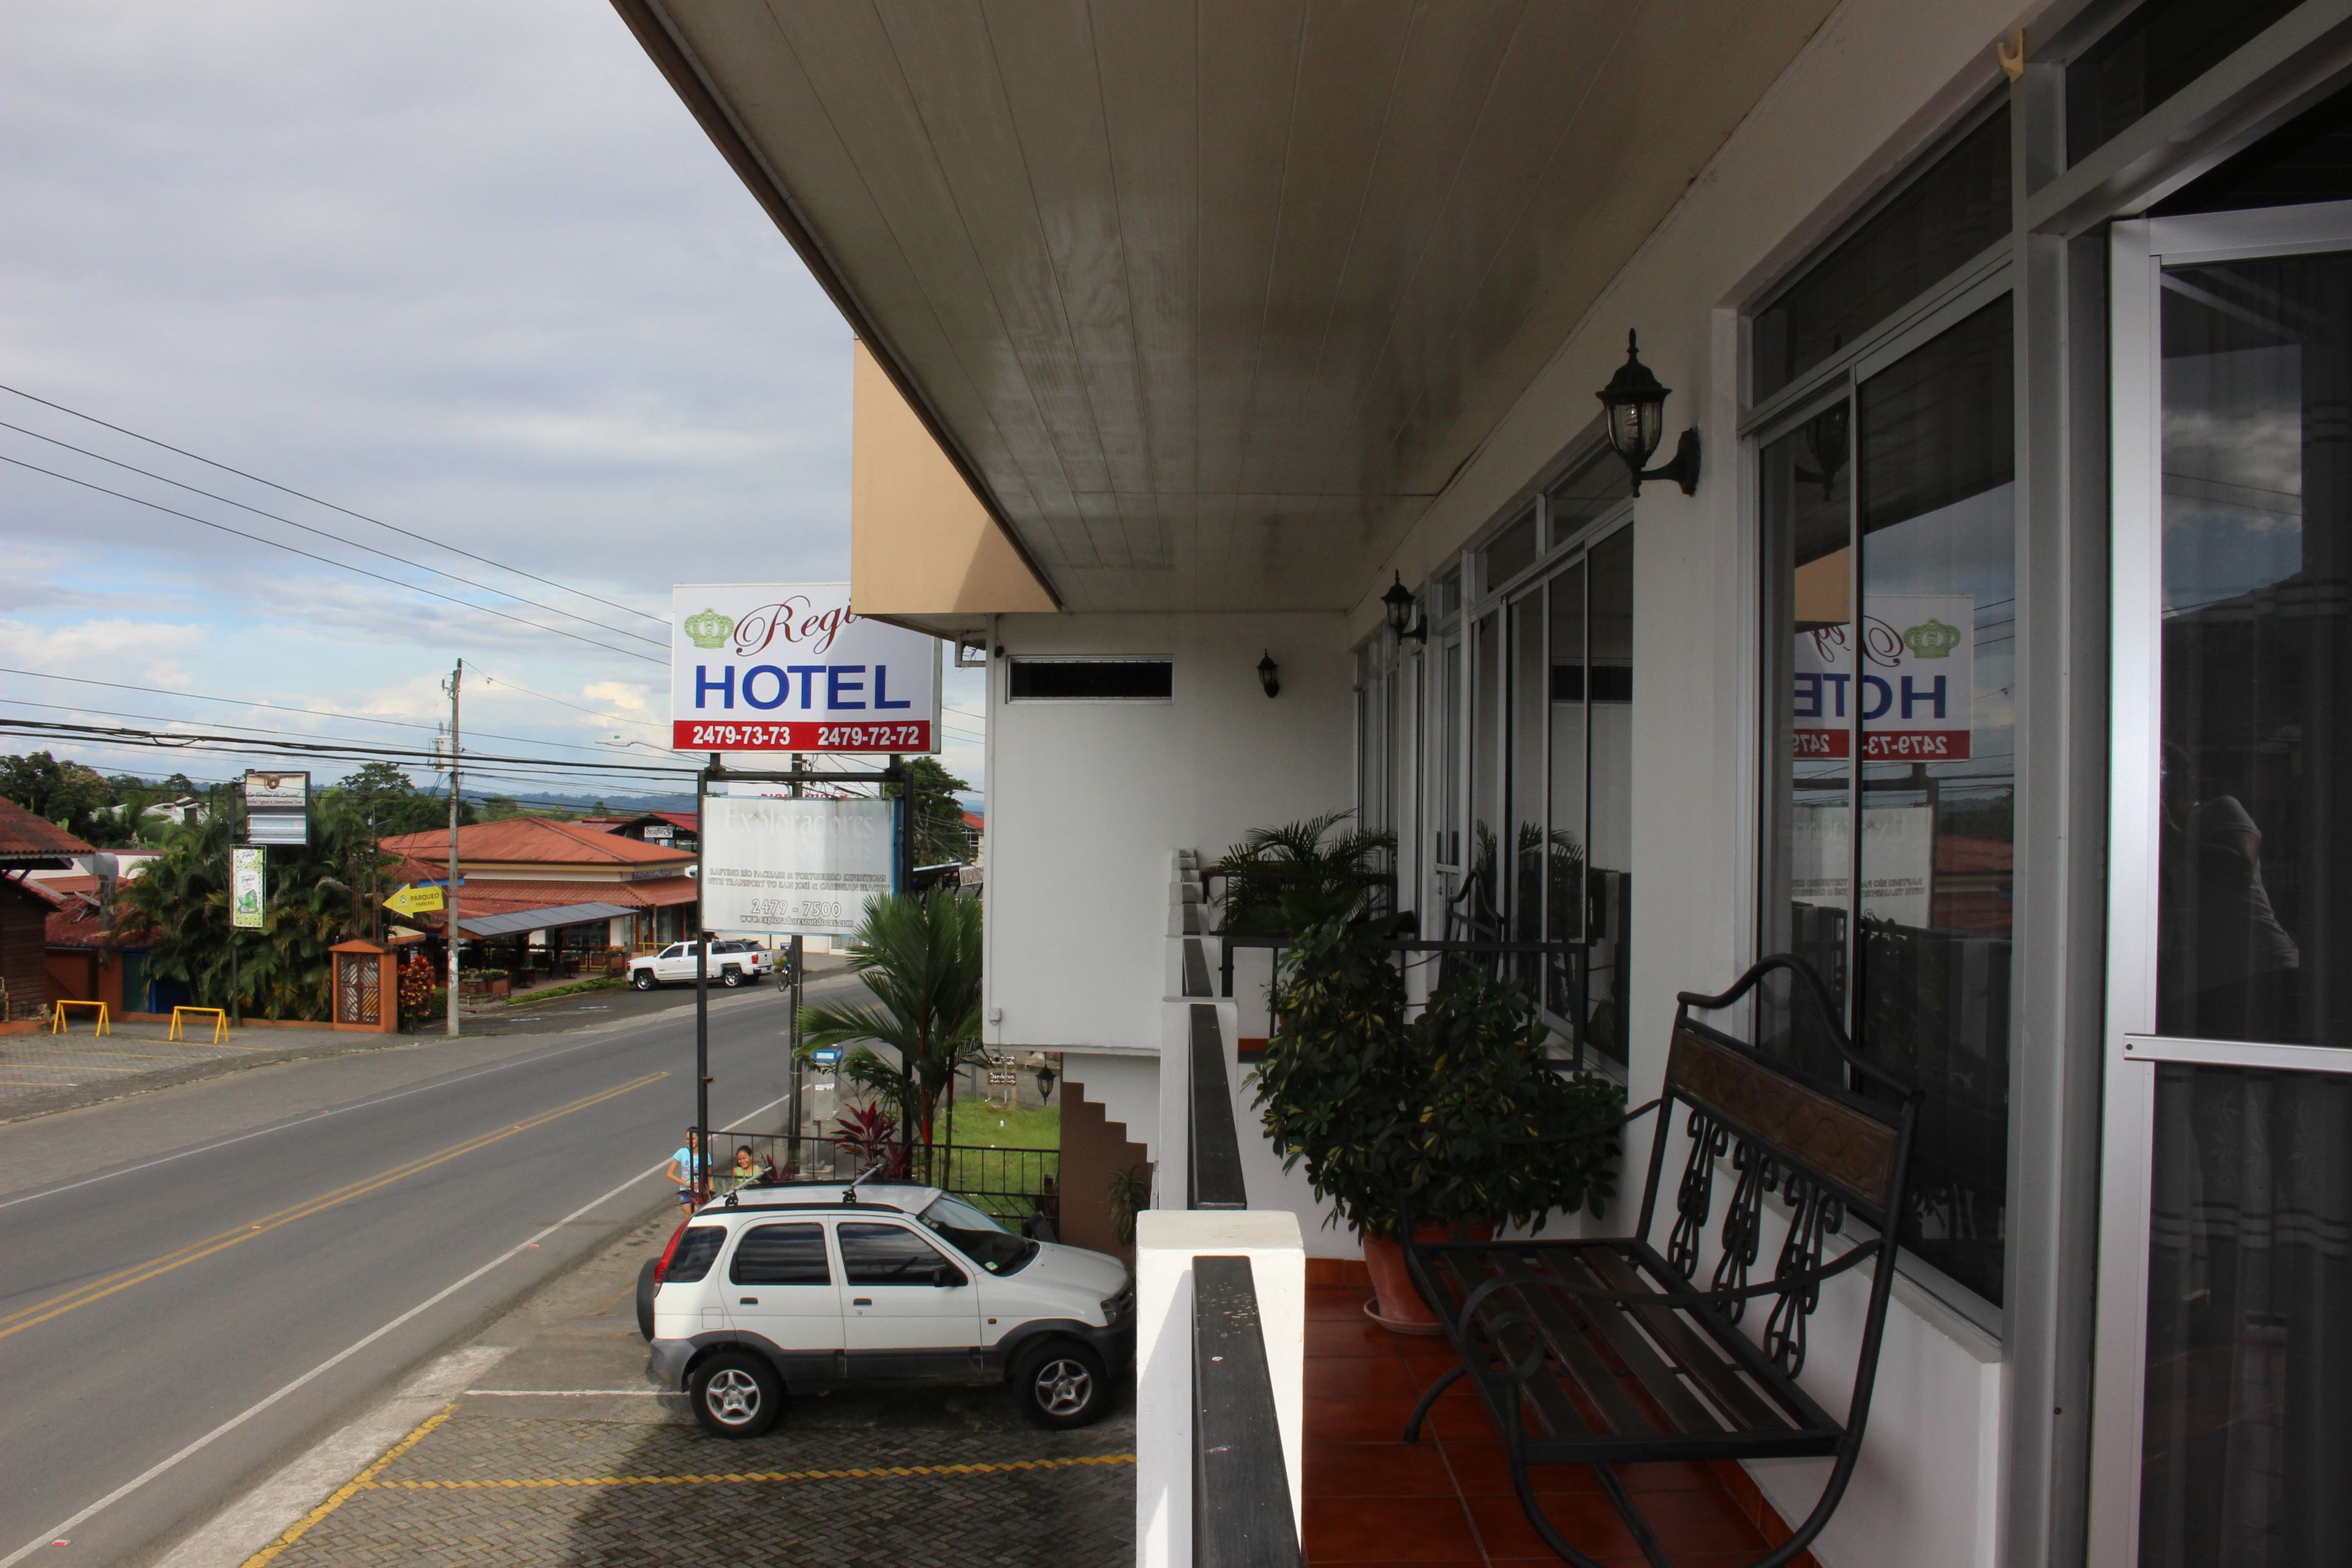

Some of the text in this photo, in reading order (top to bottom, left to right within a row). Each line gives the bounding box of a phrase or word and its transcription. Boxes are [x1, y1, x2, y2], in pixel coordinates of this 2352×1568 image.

[734, 595, 861, 657] Regi
[696, 665, 911, 710] HOTEL
[693, 725, 919, 746] 2479-73-73 2479-72-72
[635, 867, 670, 879] FARMACIA
[709, 867, 739, 877] RAFTING
[725, 878, 766, 888] TRANSPORT
[410, 893, 439, 902] PARQUEO
[751, 899, 788, 915] 2479
[802, 901, 842, 918] 7500
[740, 914, 854, 928] www.exploradoresoutdoors.com
